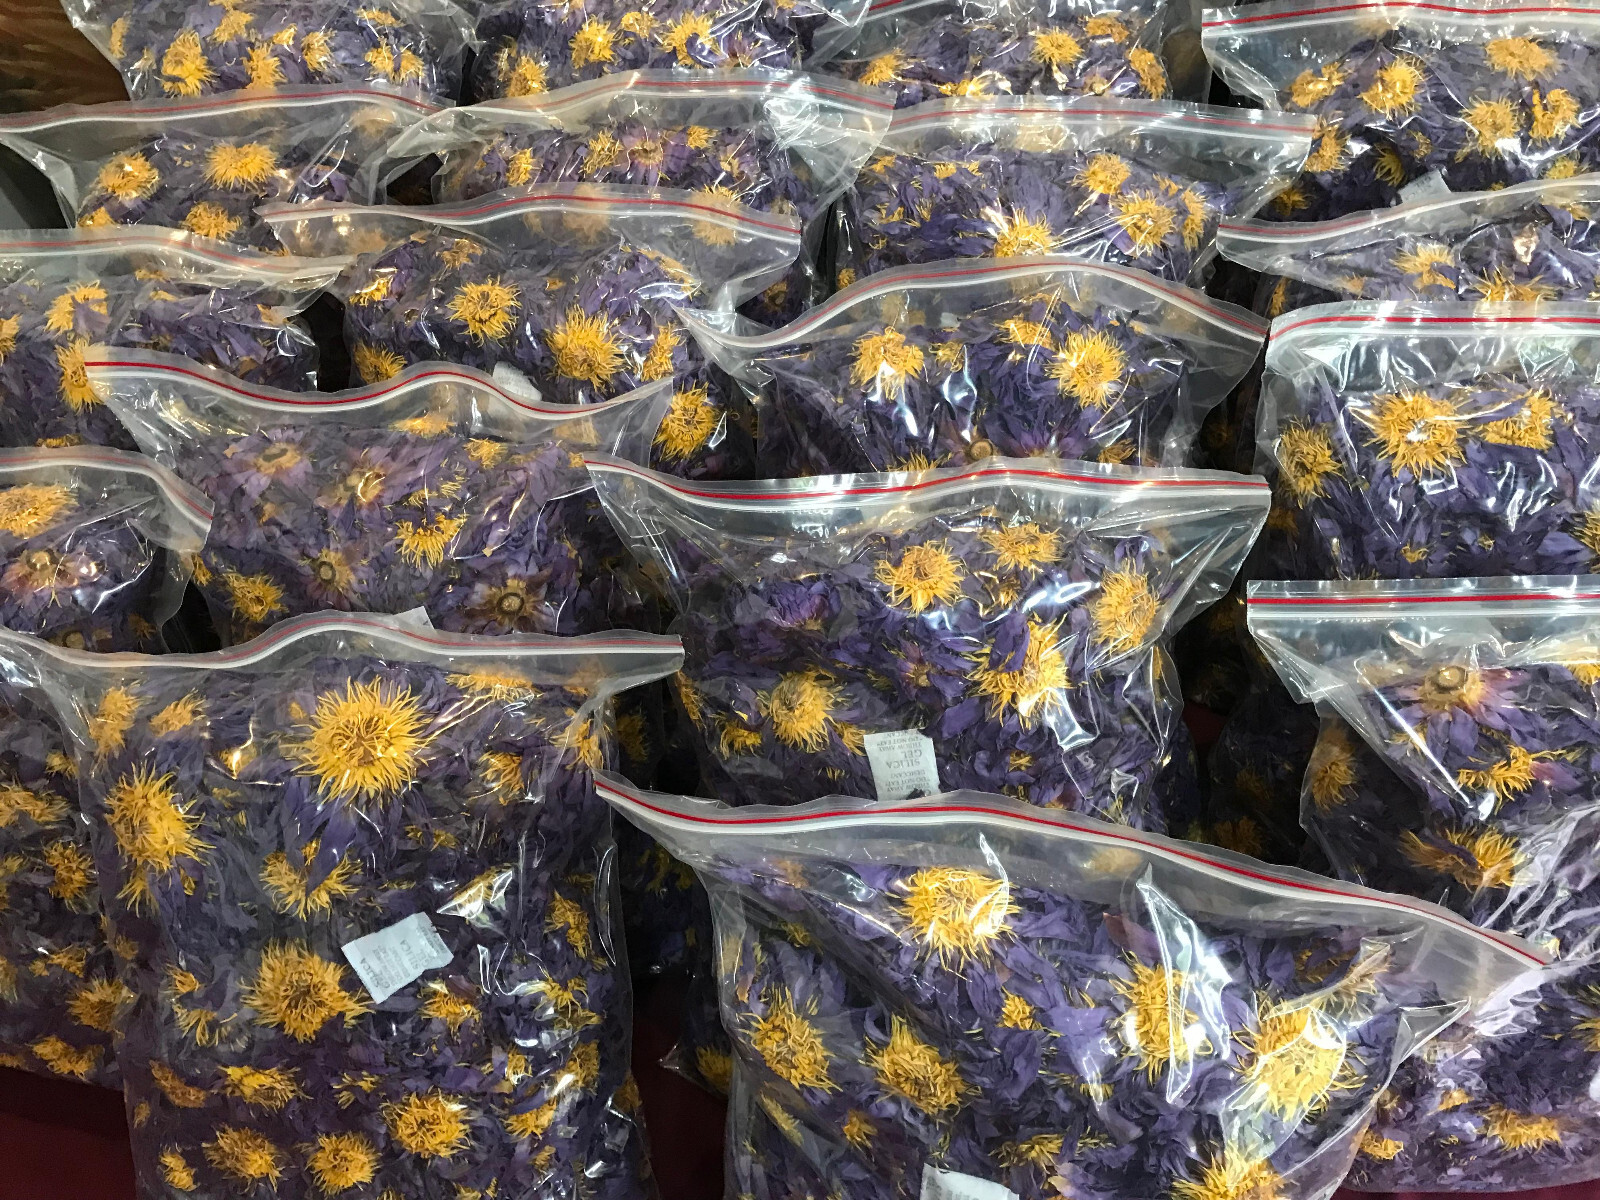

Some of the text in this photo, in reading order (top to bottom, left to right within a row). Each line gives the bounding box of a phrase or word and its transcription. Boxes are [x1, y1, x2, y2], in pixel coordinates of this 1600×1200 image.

[901, 749, 922, 758] GEL
[886, 759, 920, 769] SILICA
[400, 939, 419, 969] SILICA
[417, 950, 430, 967] GEL
[361, 957, 380, 987] SILICA
